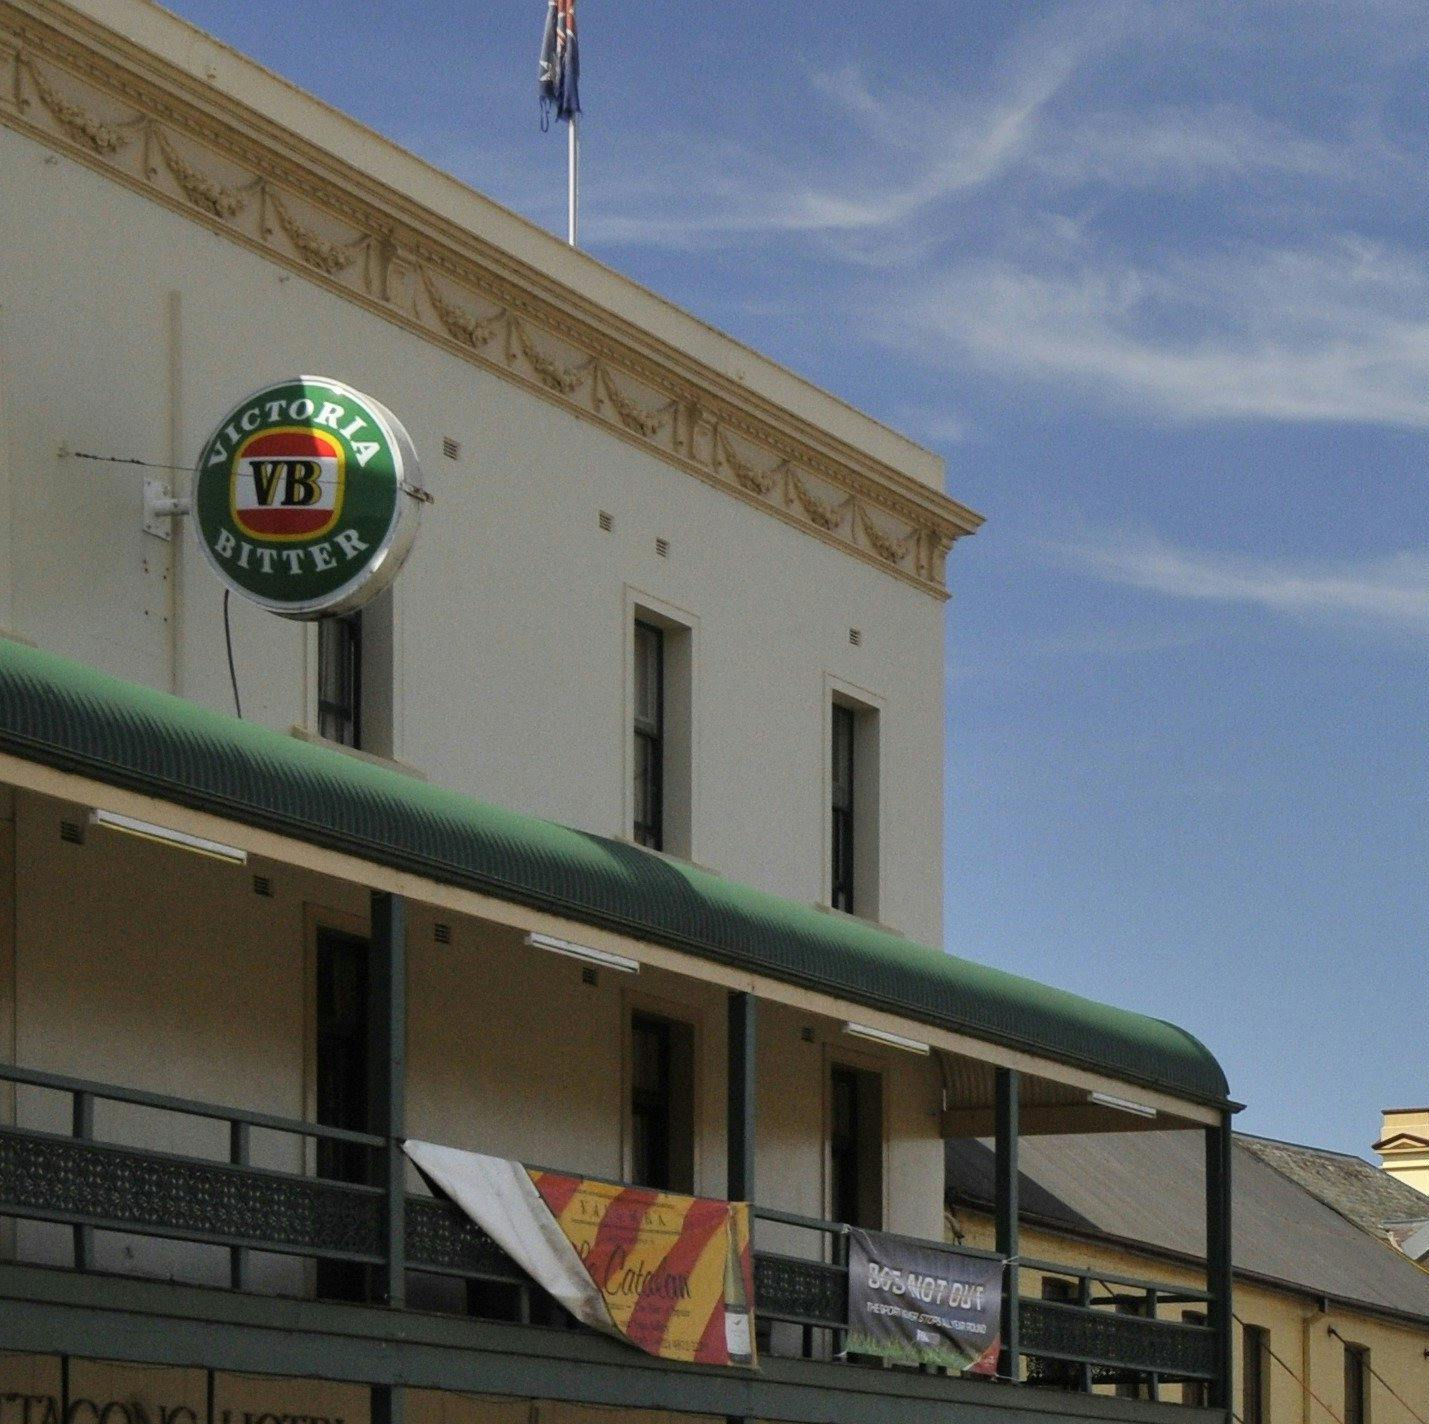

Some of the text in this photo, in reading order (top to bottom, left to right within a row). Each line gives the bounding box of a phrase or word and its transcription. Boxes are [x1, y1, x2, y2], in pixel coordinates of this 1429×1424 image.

[207, 398, 381, 468] VICTORIA
[248, 460, 323, 507] VB
[214, 528, 370, 575] BITTER
[907, 1273, 949, 1304] NOT
[949, 1282, 984, 1311] OUT
